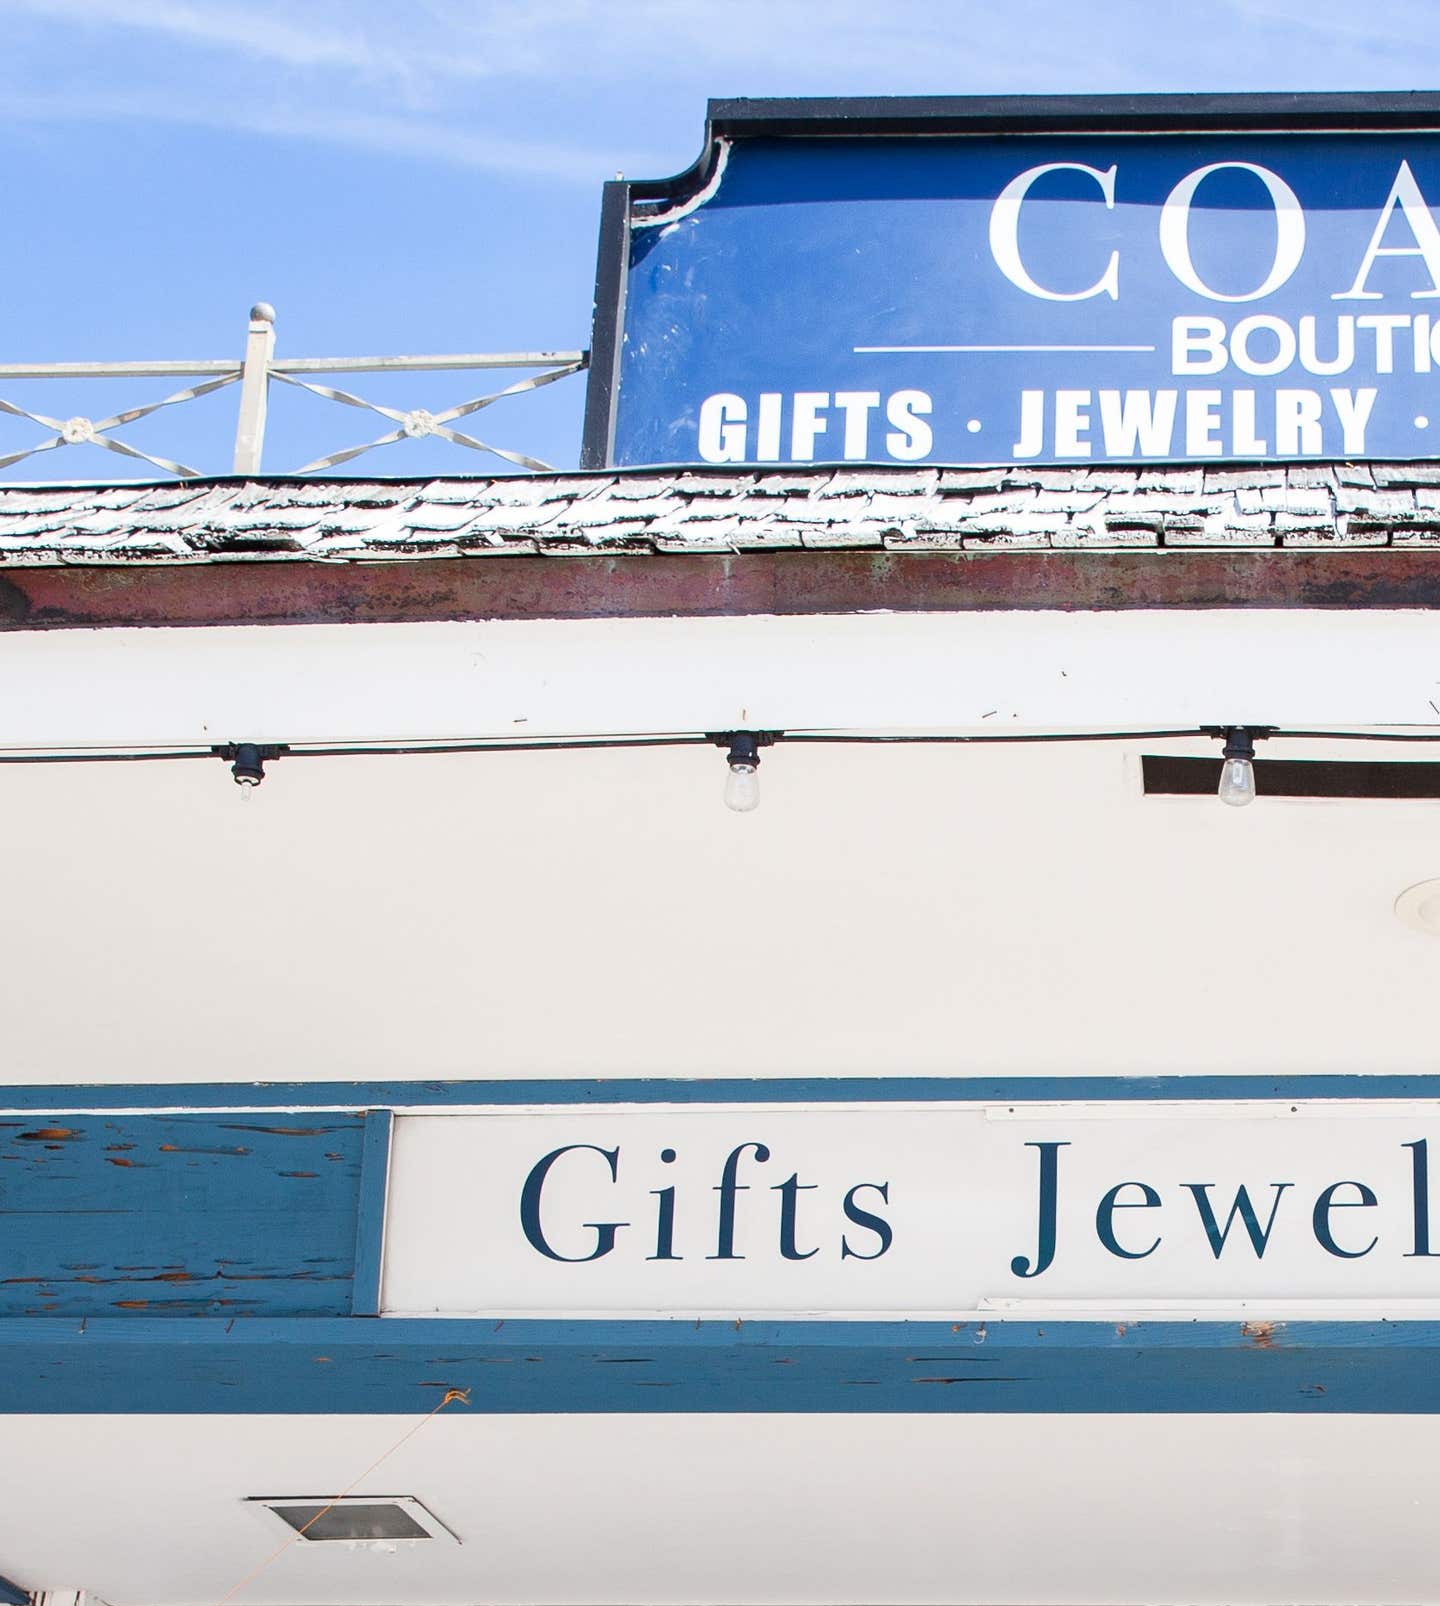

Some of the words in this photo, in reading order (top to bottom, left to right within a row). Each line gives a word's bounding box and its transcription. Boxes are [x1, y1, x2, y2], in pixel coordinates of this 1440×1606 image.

[699, 391, 933, 462] GIFTS
[1013, 389, 1373, 458] JEWELRY
[519, 1142, 894, 1263] Gifts
